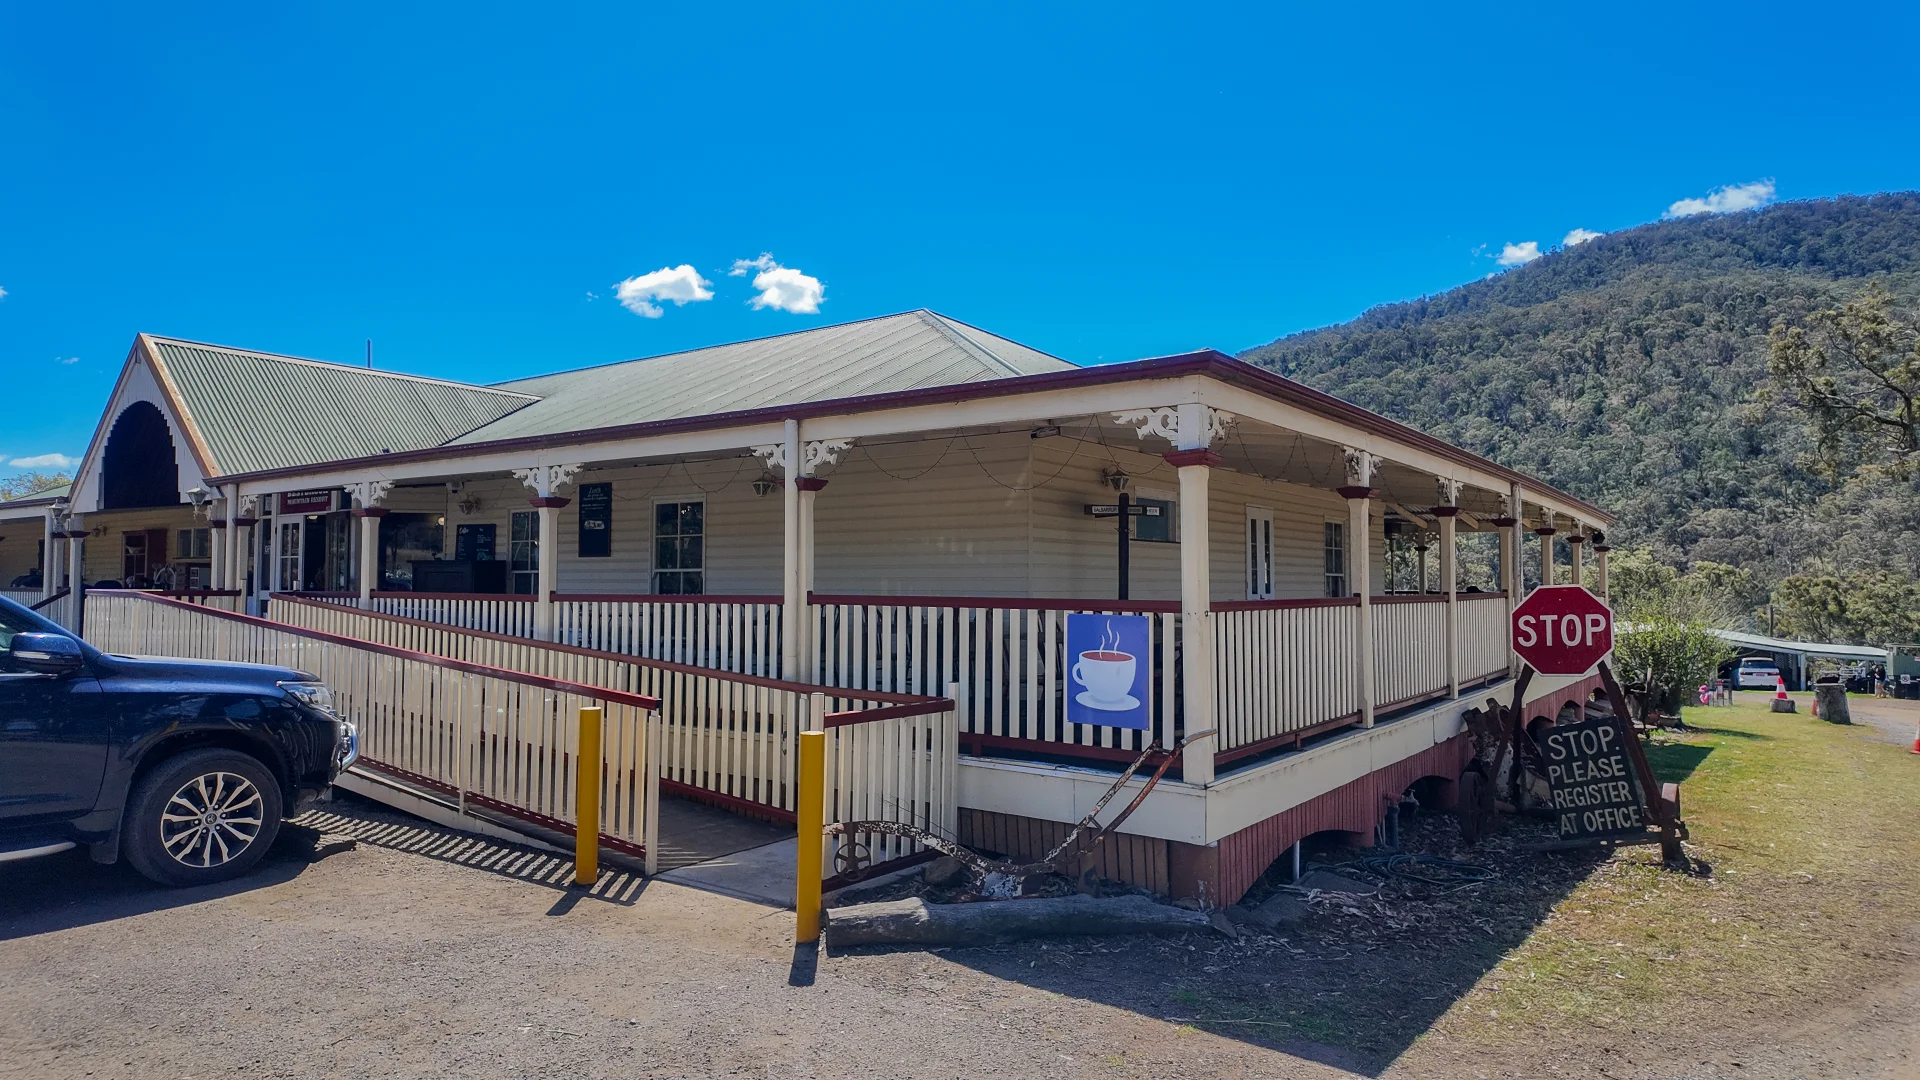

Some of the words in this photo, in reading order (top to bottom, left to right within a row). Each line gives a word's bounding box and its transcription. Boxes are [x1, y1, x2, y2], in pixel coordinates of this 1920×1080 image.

[1518, 613, 1606, 647] STOP
[1548, 755, 1626, 786] PLEASE
[1553, 780, 1632, 811] REGISTER
[1560, 813, 1578, 836] AT
[1583, 805, 1642, 833] OFFICE
